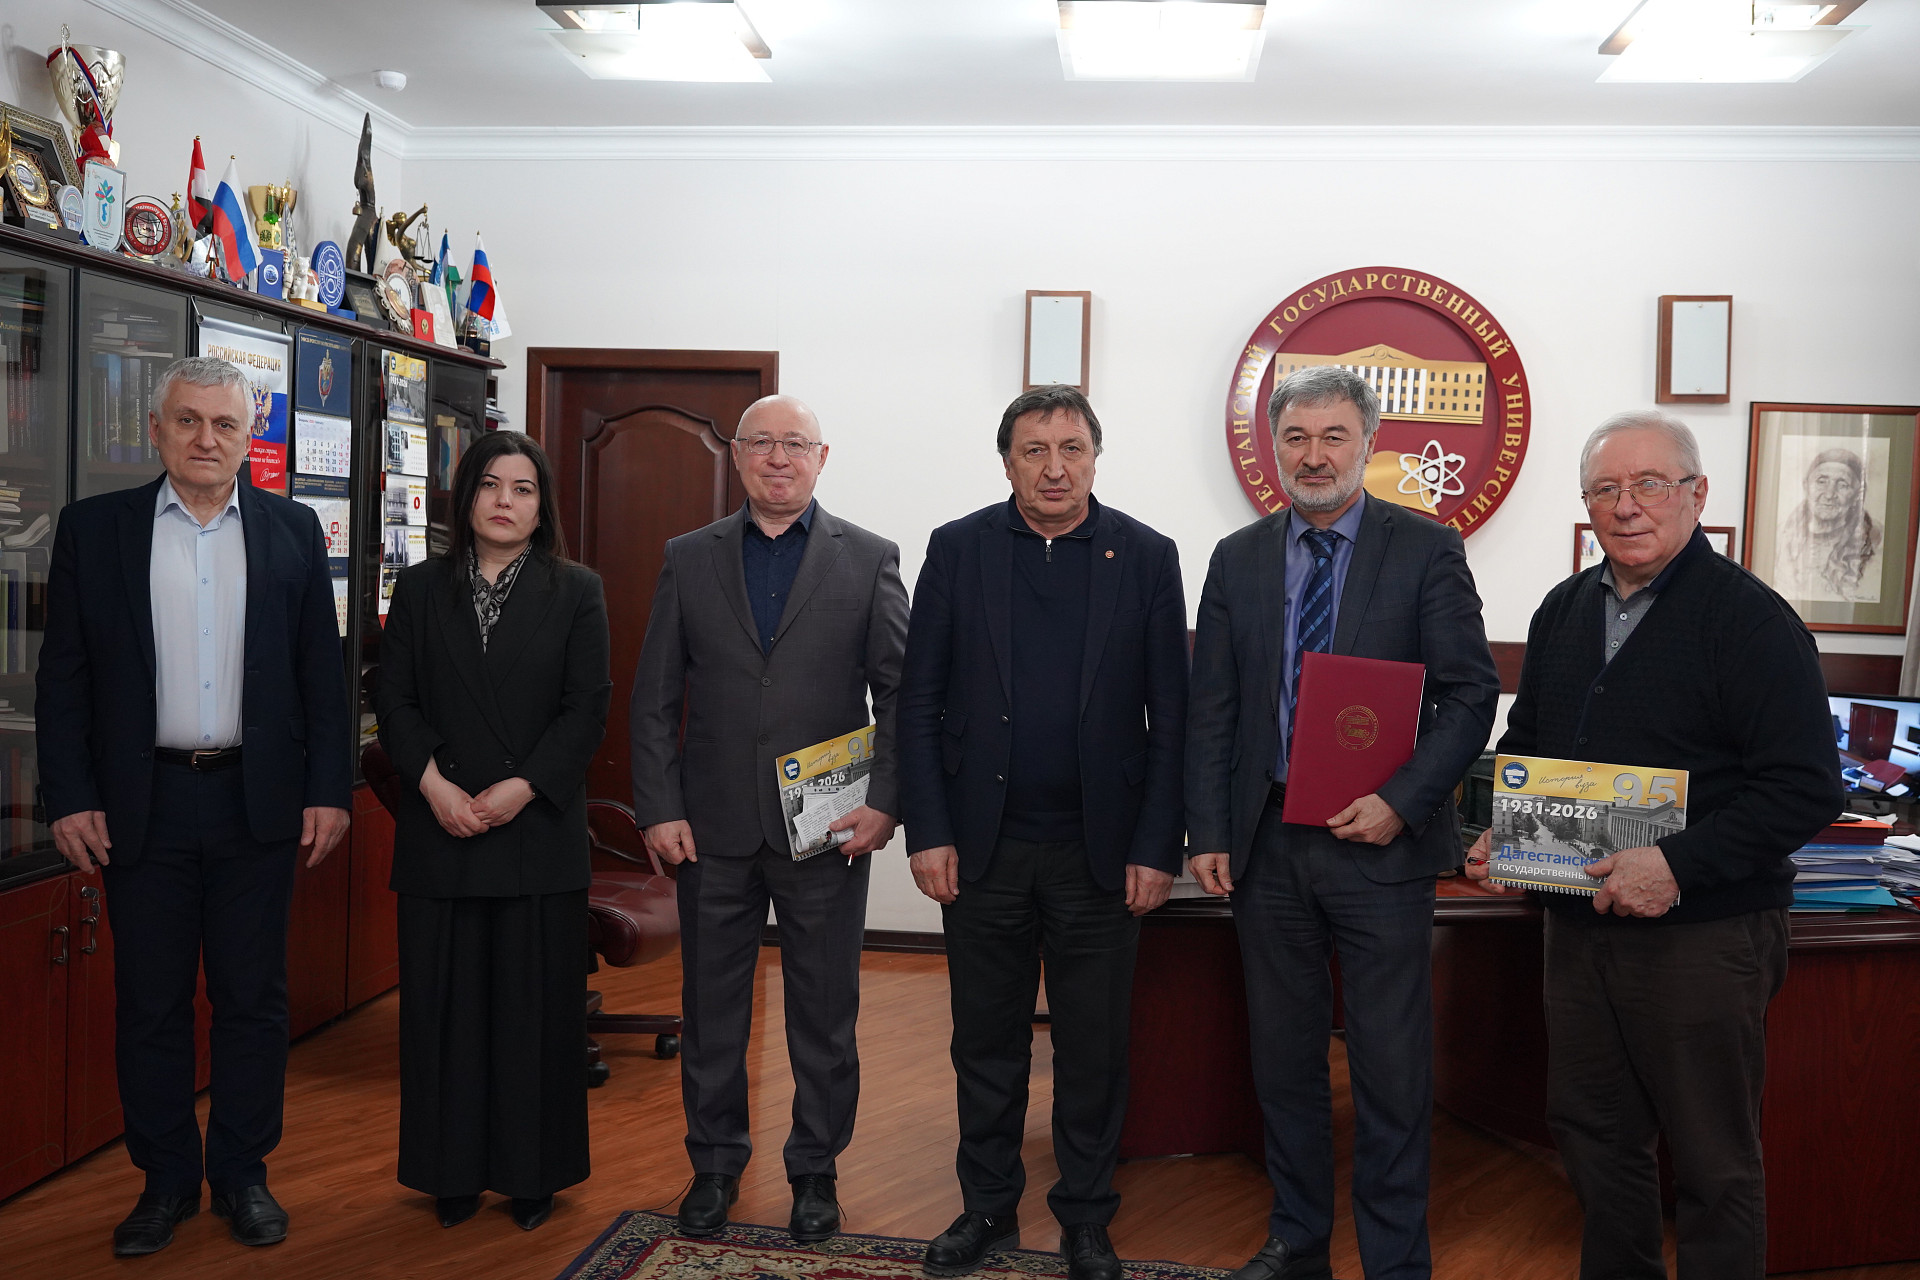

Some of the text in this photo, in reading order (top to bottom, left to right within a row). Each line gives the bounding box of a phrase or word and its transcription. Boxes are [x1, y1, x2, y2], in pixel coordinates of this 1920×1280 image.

[207, 344, 282, 372] РОССИЙСКАЯ ФЕДЕРАЦИЯ
[410, 362, 424, 381] 95
[1232, 273, 1526, 532] ГЕСТАНСКИЙ ГОСУДАРСТВЕННЫЙ УНИВЕРСИТЕ
[1538, 774, 1584, 788] История
[1575, 779, 1598, 794] вуза
[1613, 772, 1678, 809] 95
[1499, 798, 1599, 821] 1931-2026
[1497, 845, 1608, 867] Дагестански
